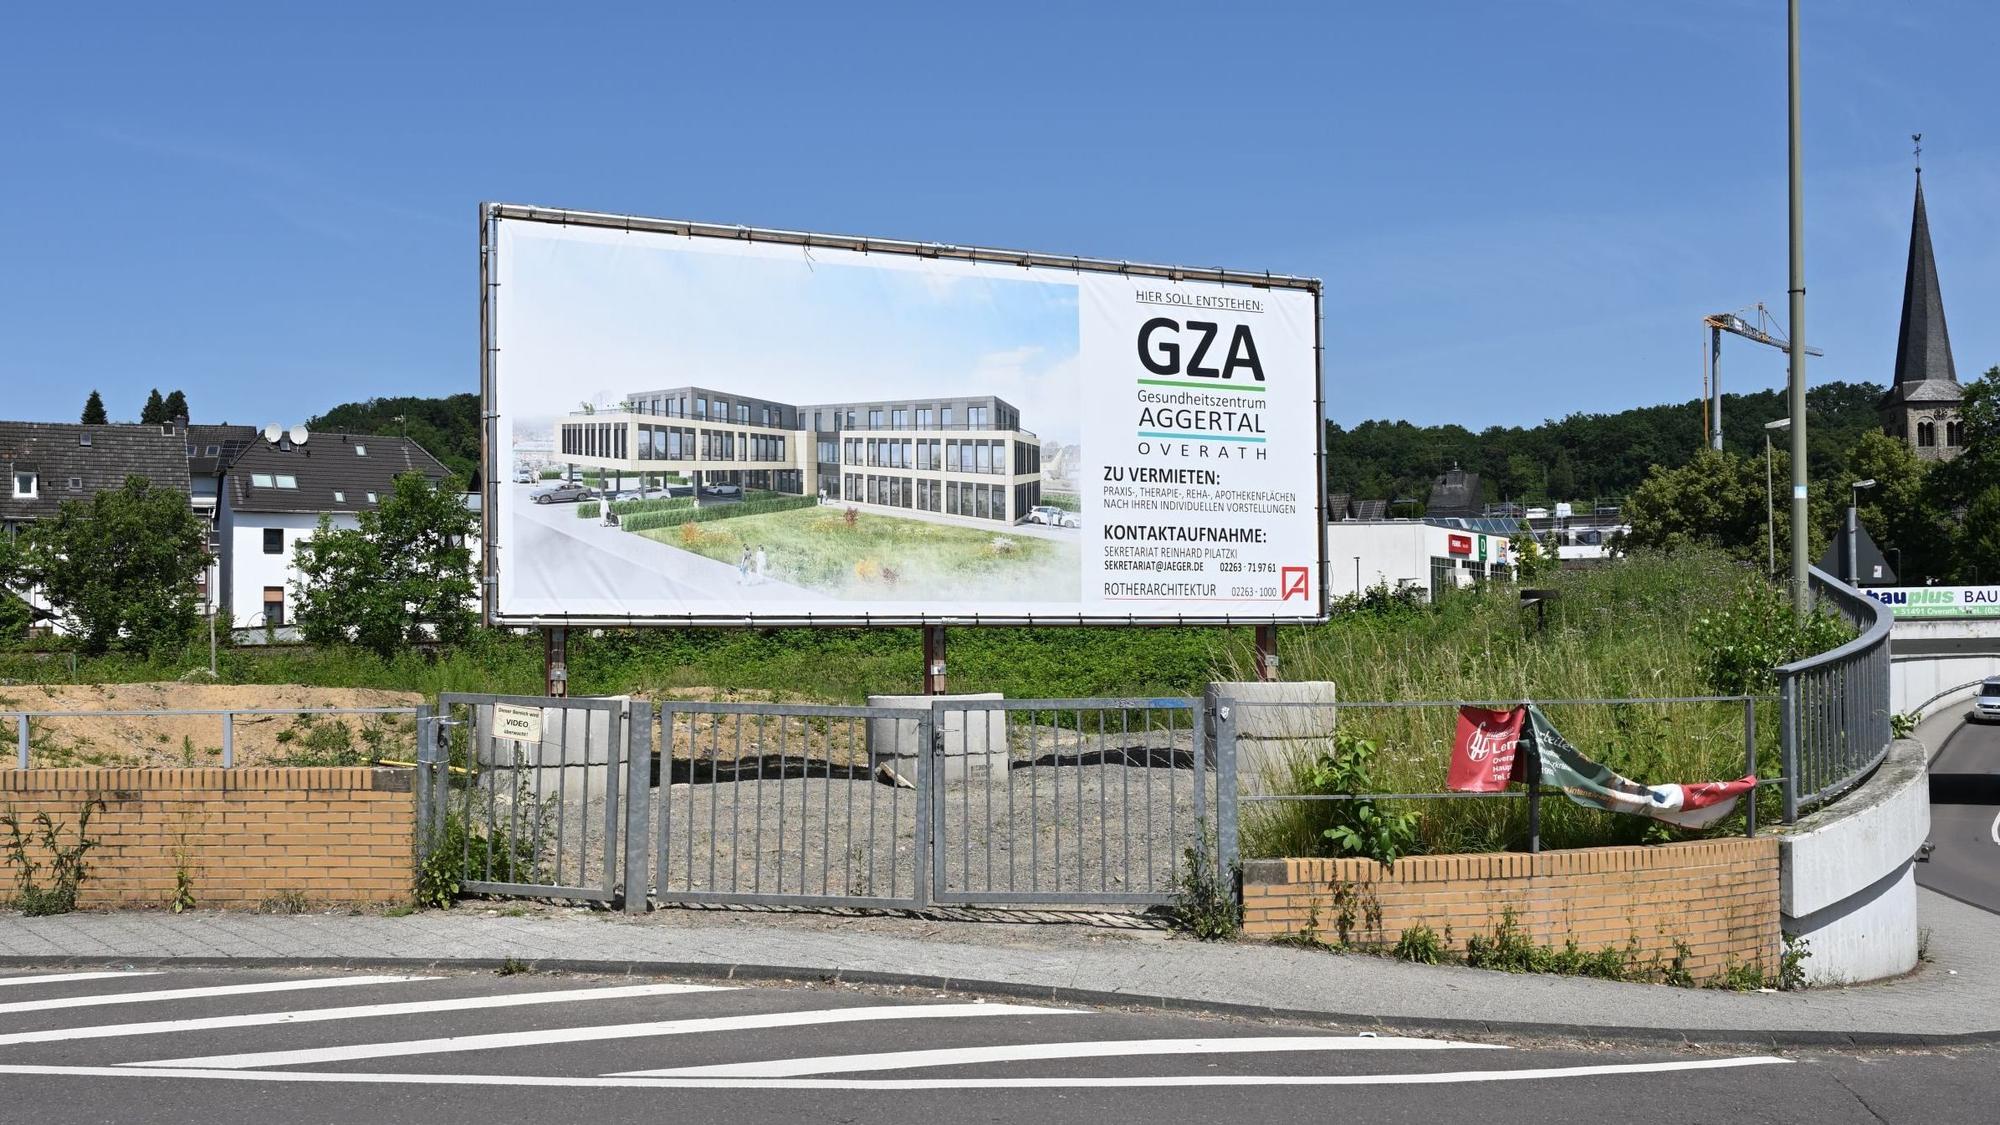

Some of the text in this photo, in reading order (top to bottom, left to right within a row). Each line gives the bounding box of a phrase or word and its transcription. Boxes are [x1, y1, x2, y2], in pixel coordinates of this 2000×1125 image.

[1136, 290, 1264, 311] HIER SOLL ENTSTEHEN:
[1137, 317, 1265, 381] GZA
[1137, 389, 1266, 409] Gesundheitszentrum
[1138, 407, 1266, 433] AGGERTAL
[1138, 441, 1267, 460] OVERATH
[1104, 466, 1220, 485] ZU VERMIETEN:
[1103, 486, 1296, 502] PRAXIS-, THERAPIE-, REHA-, APOTHEKENFLÄCHEN
[1103, 499, 1296, 514] NACH IHREN INDIVIDUELLEN VORSTELLUNGEN
[1104, 524, 1267, 543] KONTAKTAUFNAHME:
[1104, 546, 1238, 559] SEKRETARIAT REINHARD PILATZKI
[1104, 560, 1204, 572] SEKRETARIAT@JAEGER.DE
[1220, 562, 1242, 572] 02263
[1104, 583, 1216, 596] ROTHERARCHITEKTUR
[1231, 587, 1254, 597] 02263
[1259, 587, 1277, 597] 1000
[1964, 590, 1998, 603] BAU
[506, 719, 529, 728] VIDEO
